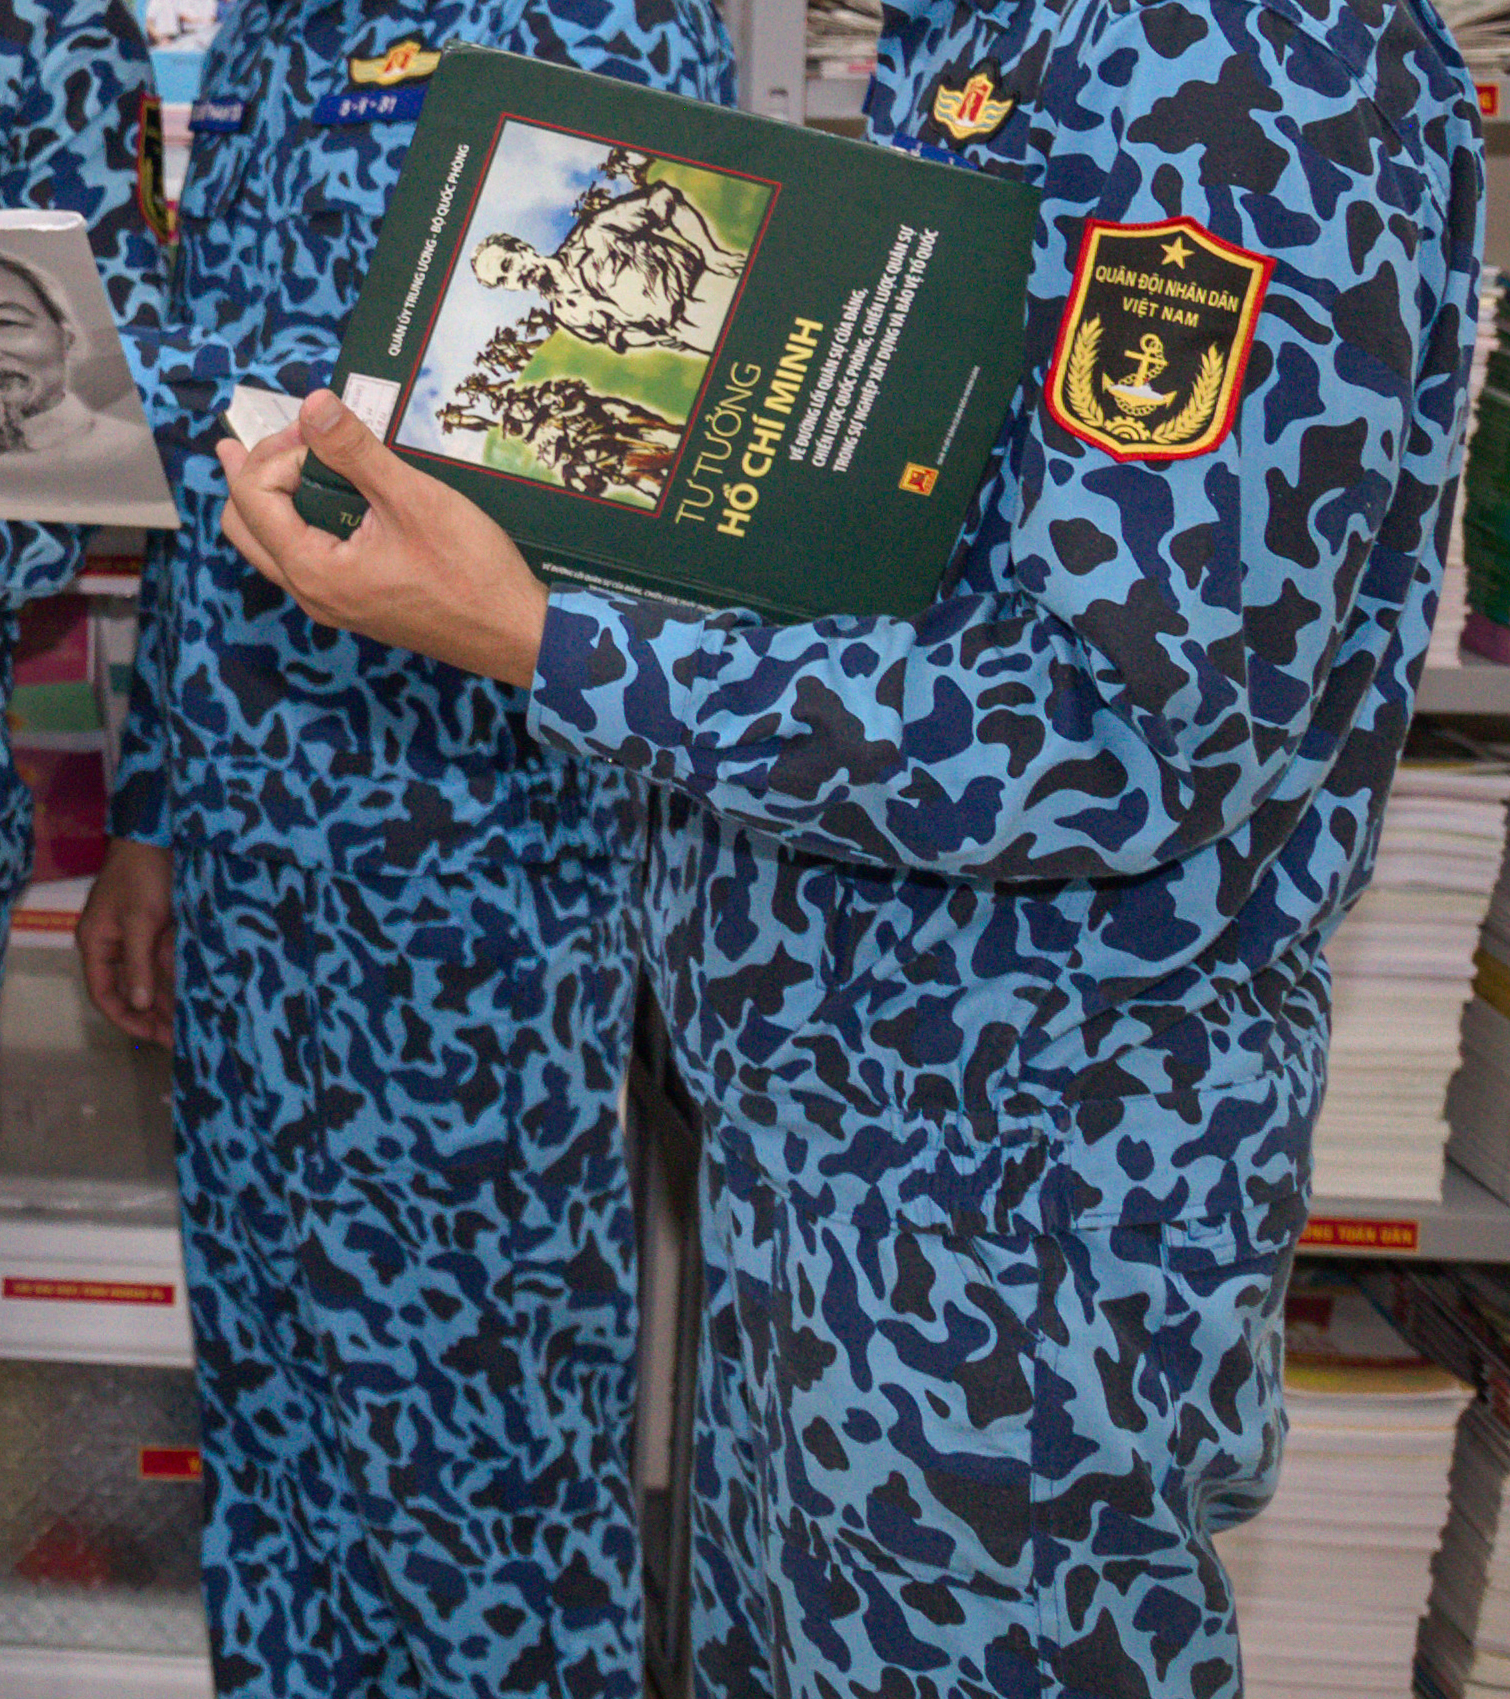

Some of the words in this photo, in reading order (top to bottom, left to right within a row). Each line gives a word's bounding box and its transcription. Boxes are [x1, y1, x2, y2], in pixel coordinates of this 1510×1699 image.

[445, 141, 471, 184] PHÒNG
[432, 182, 457, 217] QUỐC
[428, 214, 448, 234] BỘ
[895, 223, 919, 245] SỰ
[415, 237, 438, 272] ƯƠNG
[883, 239, 910, 276] QUÂN
[912, 225, 939, 261] QUỐC
[901, 271, 925, 292] VỆ
[905, 256, 927, 276] TỔ
[403, 270, 426, 309] TRUNG
[839, 282, 869, 323] ĐẢNG,
[872, 271, 900, 304] LƯỢC
[892, 286, 916, 313] BẢO
[1095, 265, 1137, 287] QUÂN
[1138, 273, 1163, 295] ĐỘI
[1165, 279, 1207, 305] NHÂN
[1208, 290, 1239, 313] DÂN
[395, 307, 413, 325] ỦY
[859, 299, 886, 337] CHIẾN
[886, 309, 907, 329] VÀ
[1123, 296, 1159, 318] VIỆT
[1161, 307, 1200, 327] NAM
[385, 322, 408, 357] QUÂN
[830, 317, 855, 344] CỦA
[875, 325, 903, 362] DỰNG
[762, 313, 824, 416] MINH
[826, 340, 850, 361] SỰ
[844, 332, 875, 379] PHÒNG,
[814, 356, 840, 392] QUÂN
[867, 357, 888, 381] XÂY
[806, 387, 828, 409] LỐI
[831, 373, 857, 408] QUỐC
[851, 377, 883, 423] NGHIỆP
[685, 354, 763, 485] TƯỞNG
[793, 405, 822, 448] ĐƯỜNG
[822, 404, 848, 436] LƯỢC
[846, 418, 868, 438] SỰ
[732, 411, 787, 481] CHÍ
[786, 443, 807, 462] VỀ
[808, 431, 835, 468] CHIẾN
[832, 433, 858, 474] TRONG
[671, 477, 717, 532] TƯ
[707, 475, 762, 540] HỒ
